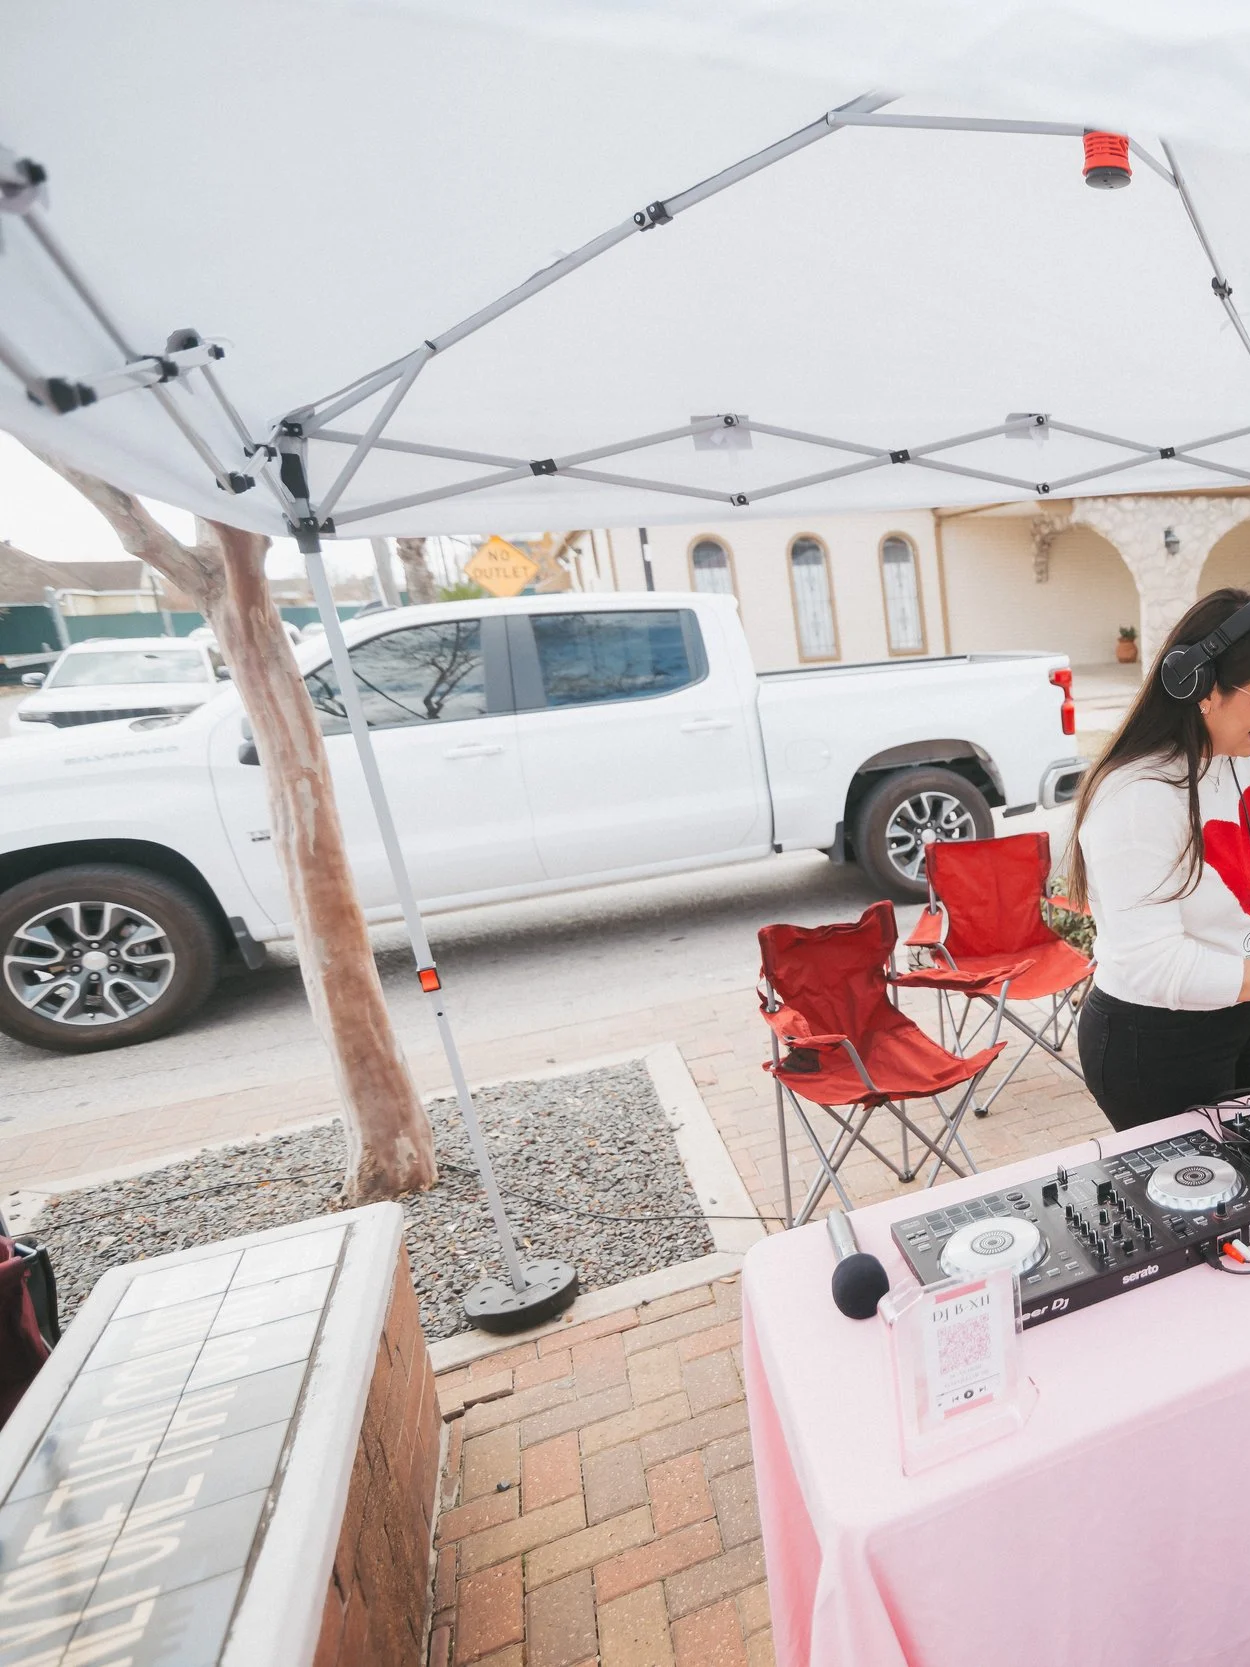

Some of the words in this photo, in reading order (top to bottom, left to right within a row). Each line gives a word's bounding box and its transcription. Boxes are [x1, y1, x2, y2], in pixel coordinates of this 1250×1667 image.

[487, 548, 511, 562] NO
[473, 565, 529, 580] OUTLET
[1122, 1264, 1160, 1285] serato
[932, 1307, 950, 1323] DJ
[43, 1386, 239, 1516] THAT
[0, 1473, 204, 1614] ONE
